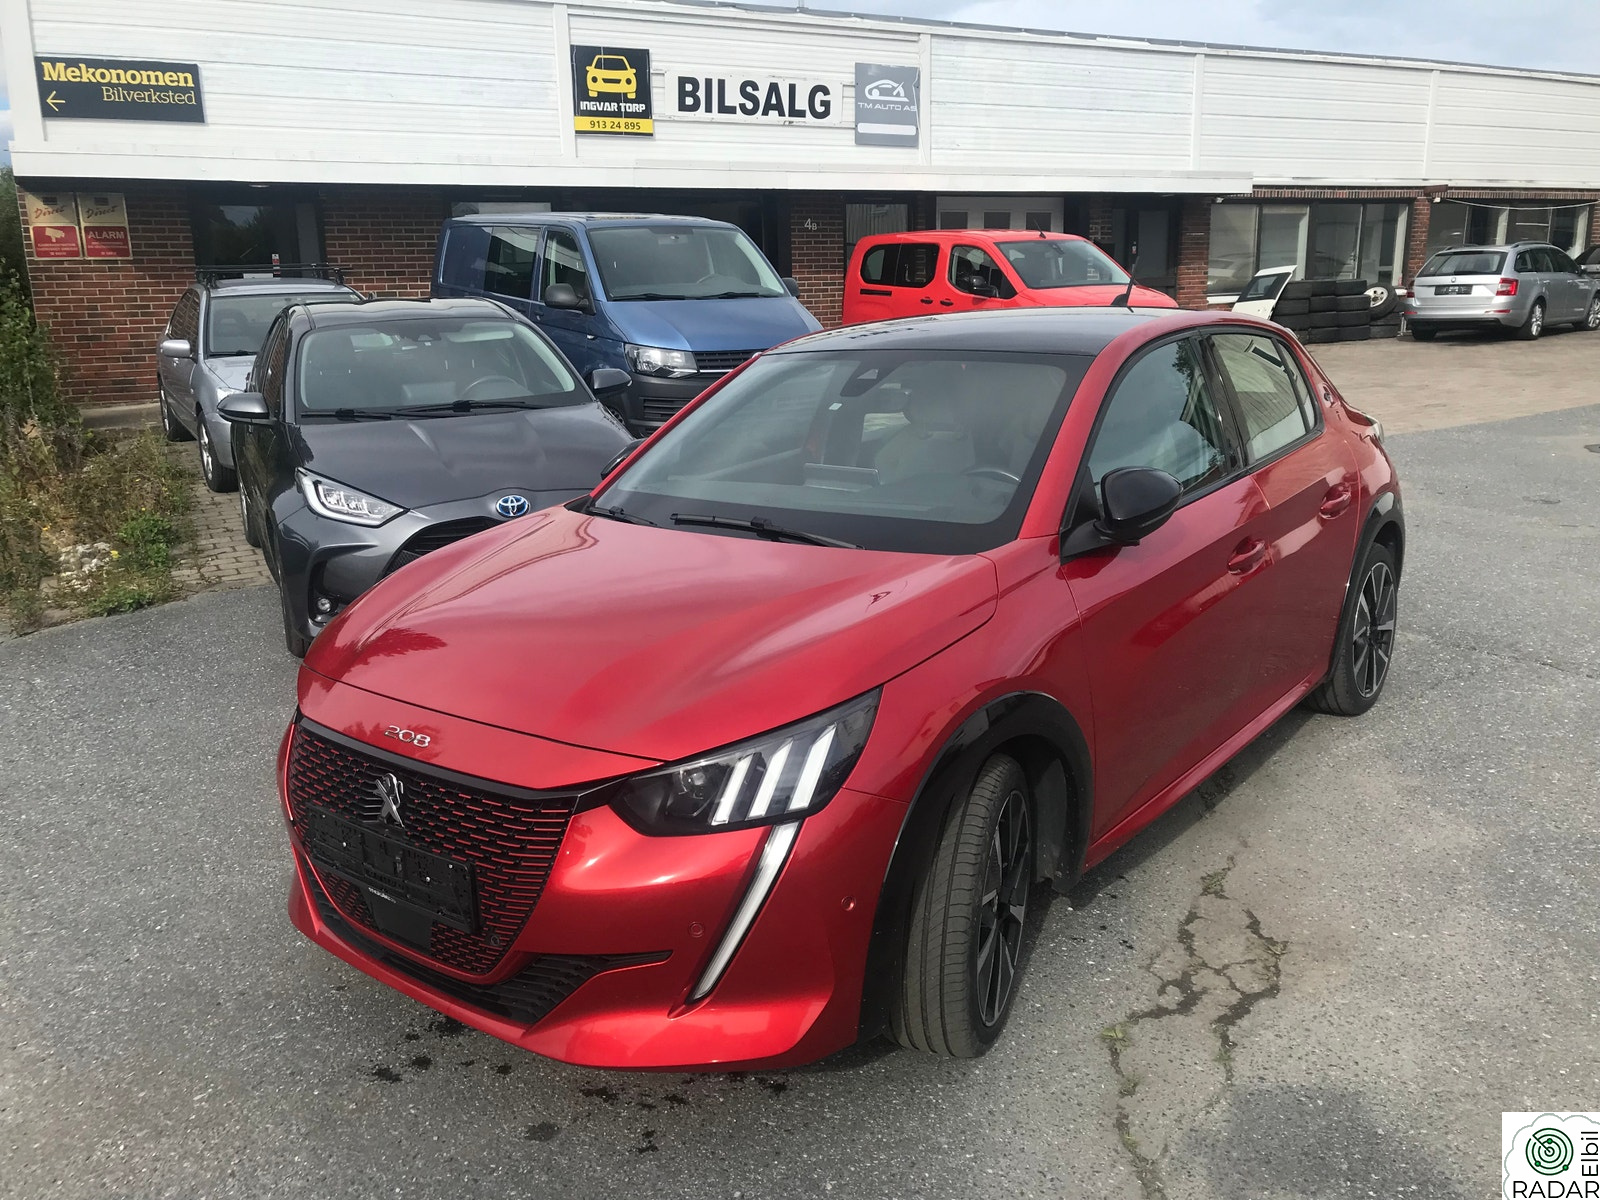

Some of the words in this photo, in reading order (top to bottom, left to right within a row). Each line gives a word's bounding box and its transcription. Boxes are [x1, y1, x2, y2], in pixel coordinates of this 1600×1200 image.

[41, 62, 195, 87] Mekonomen
[101, 86, 197, 105] Bilverksted
[677, 76, 831, 120] BILSALG
[580, 101, 618, 112] INGVAR
[619, 102, 646, 113] TORP
[874, 103, 902, 111] AUTO
[589, 120, 607, 129] 913
[610, 121, 621, 130] 24
[624, 121, 641, 131] 895
[88, 230, 125, 240] ALARM
[384, 725, 431, 747] 208
